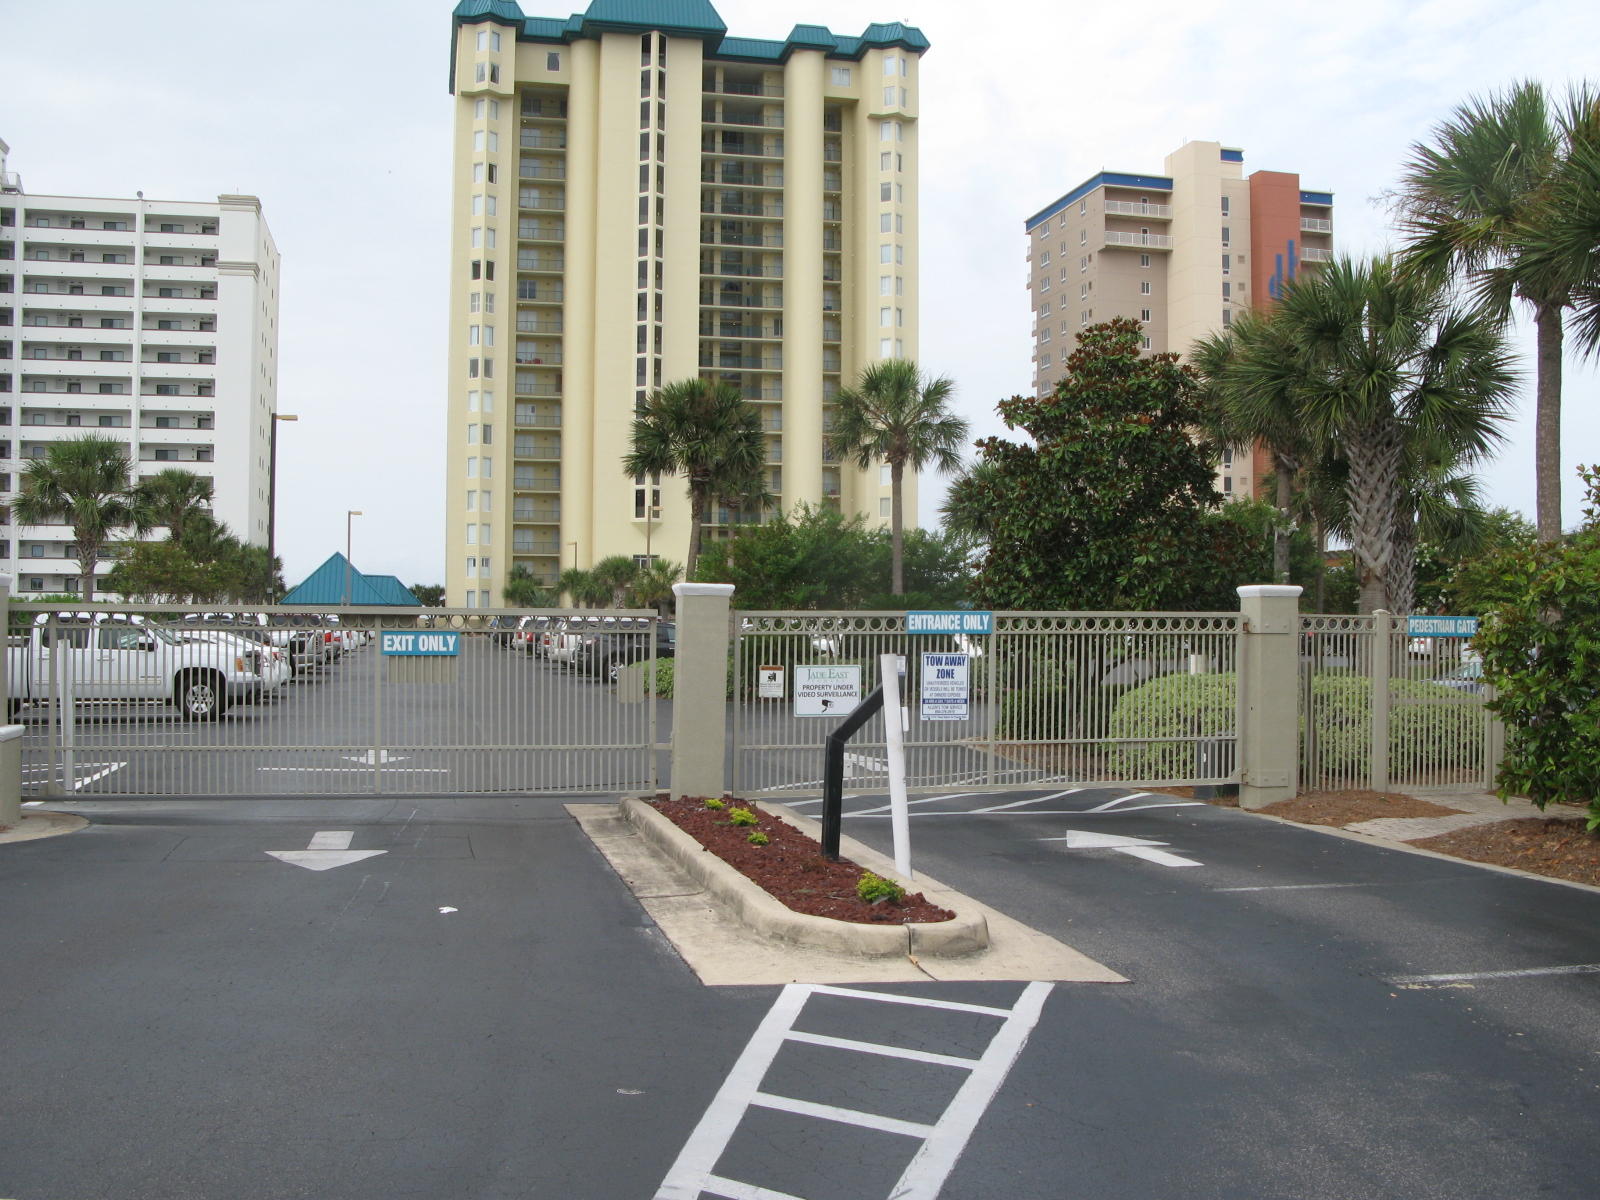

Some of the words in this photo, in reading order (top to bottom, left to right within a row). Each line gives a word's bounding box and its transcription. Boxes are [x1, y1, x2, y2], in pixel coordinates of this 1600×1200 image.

[908, 614, 961, 630] ENTRANCE
[963, 614, 990, 630] ONLY
[1409, 619, 1455, 633] PEDESTRIAN
[1456, 619, 1476, 633] GATE
[383, 634, 415, 651] EXIT
[418, 634, 457, 651] ONLY
[925, 656, 943, 666] TOW
[944, 656, 966, 666] AWAY
[828, 669, 849, 679] EAST
[936, 669, 955, 679] ZONE
